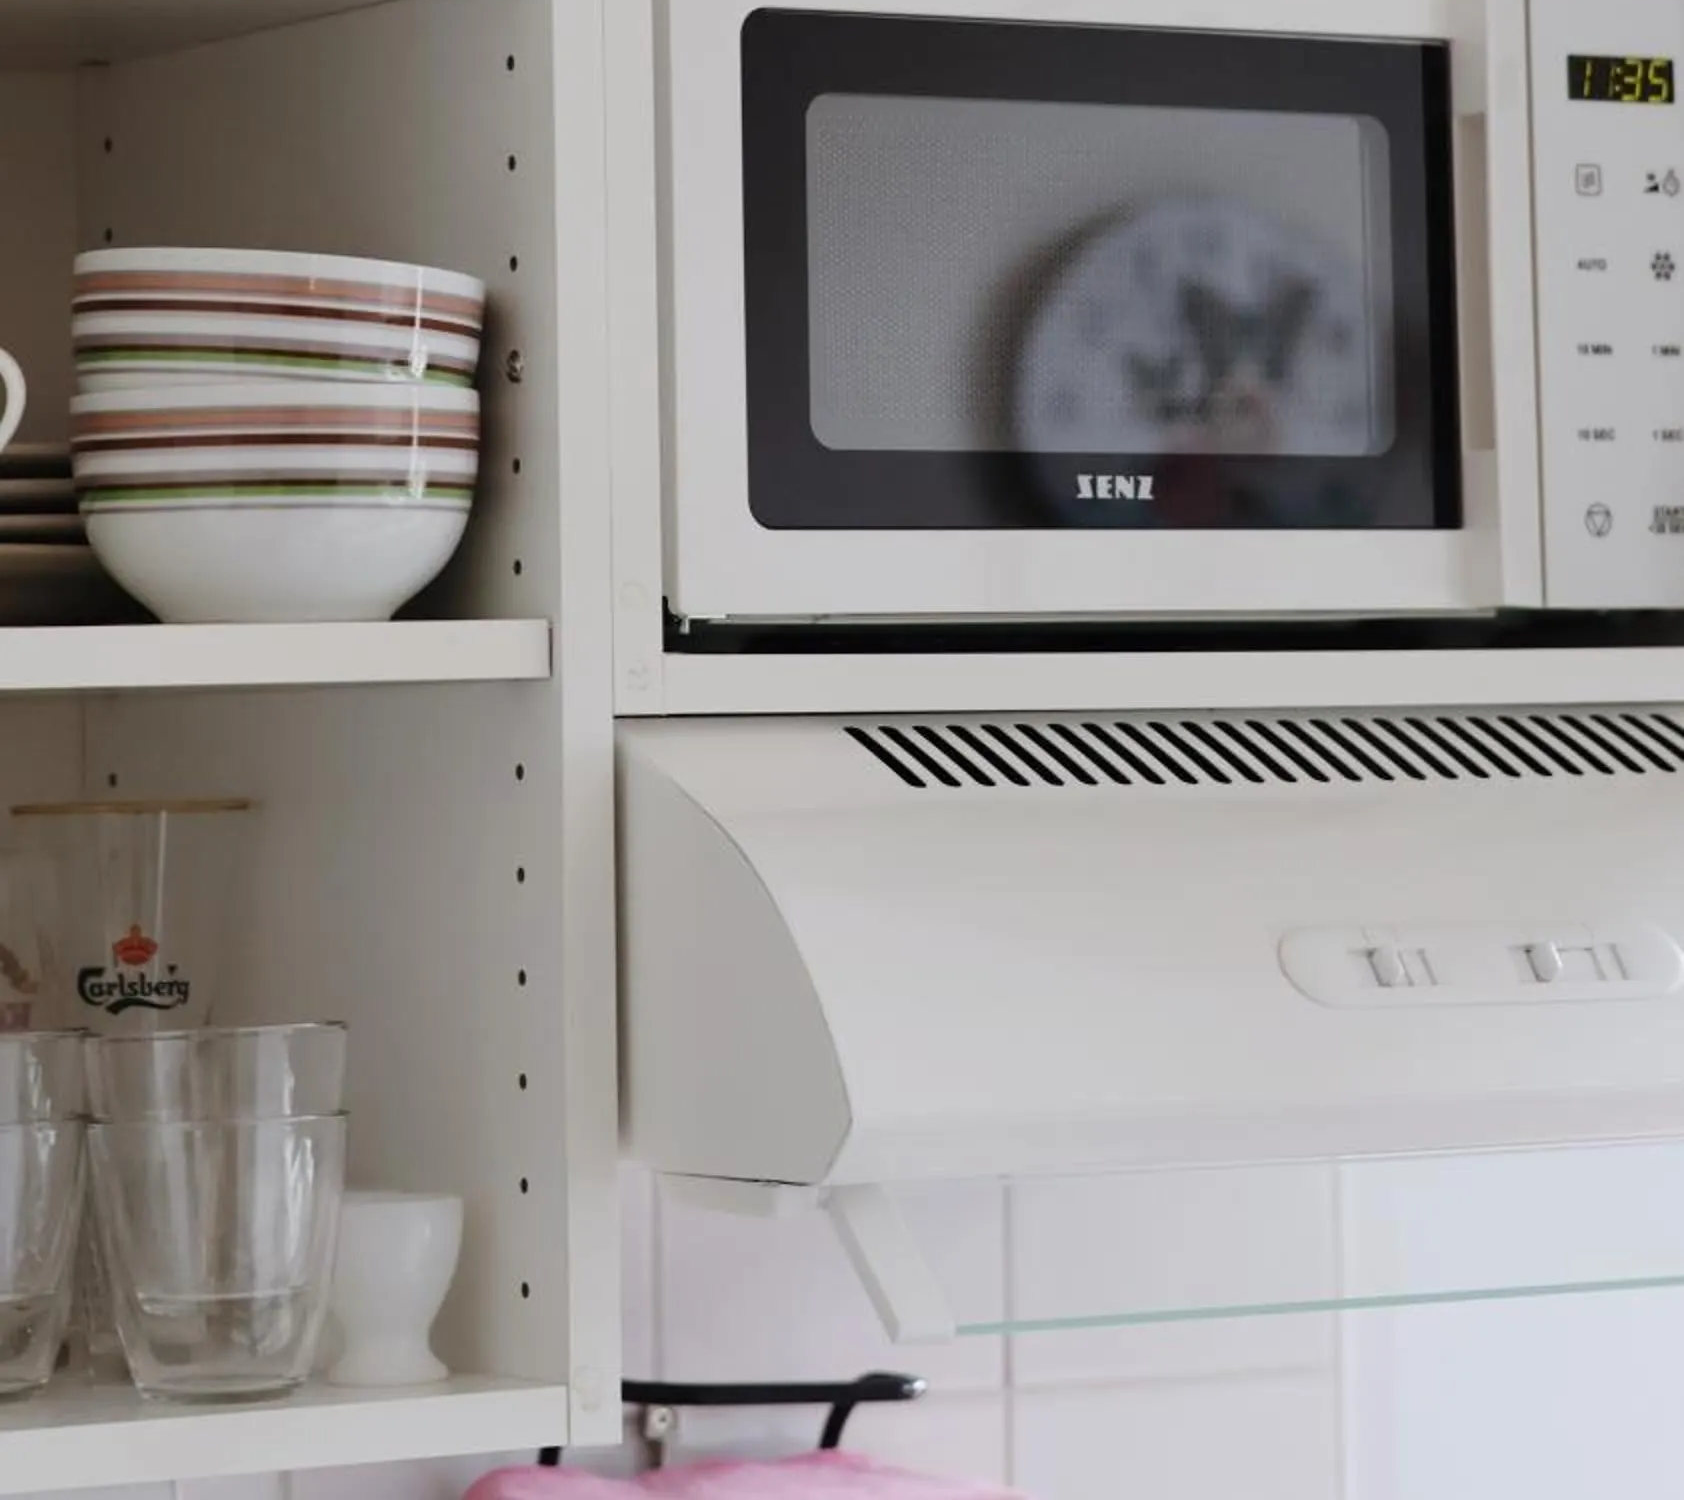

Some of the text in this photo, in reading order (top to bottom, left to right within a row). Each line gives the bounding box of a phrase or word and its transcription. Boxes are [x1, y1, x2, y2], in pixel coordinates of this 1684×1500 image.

[1583, 59, 1669, 102] 11:35
[1577, 258, 1607, 271] AUTO
[1076, 474, 1154, 501] SENZ
[77, 964, 190, 1015] Carlsberg
